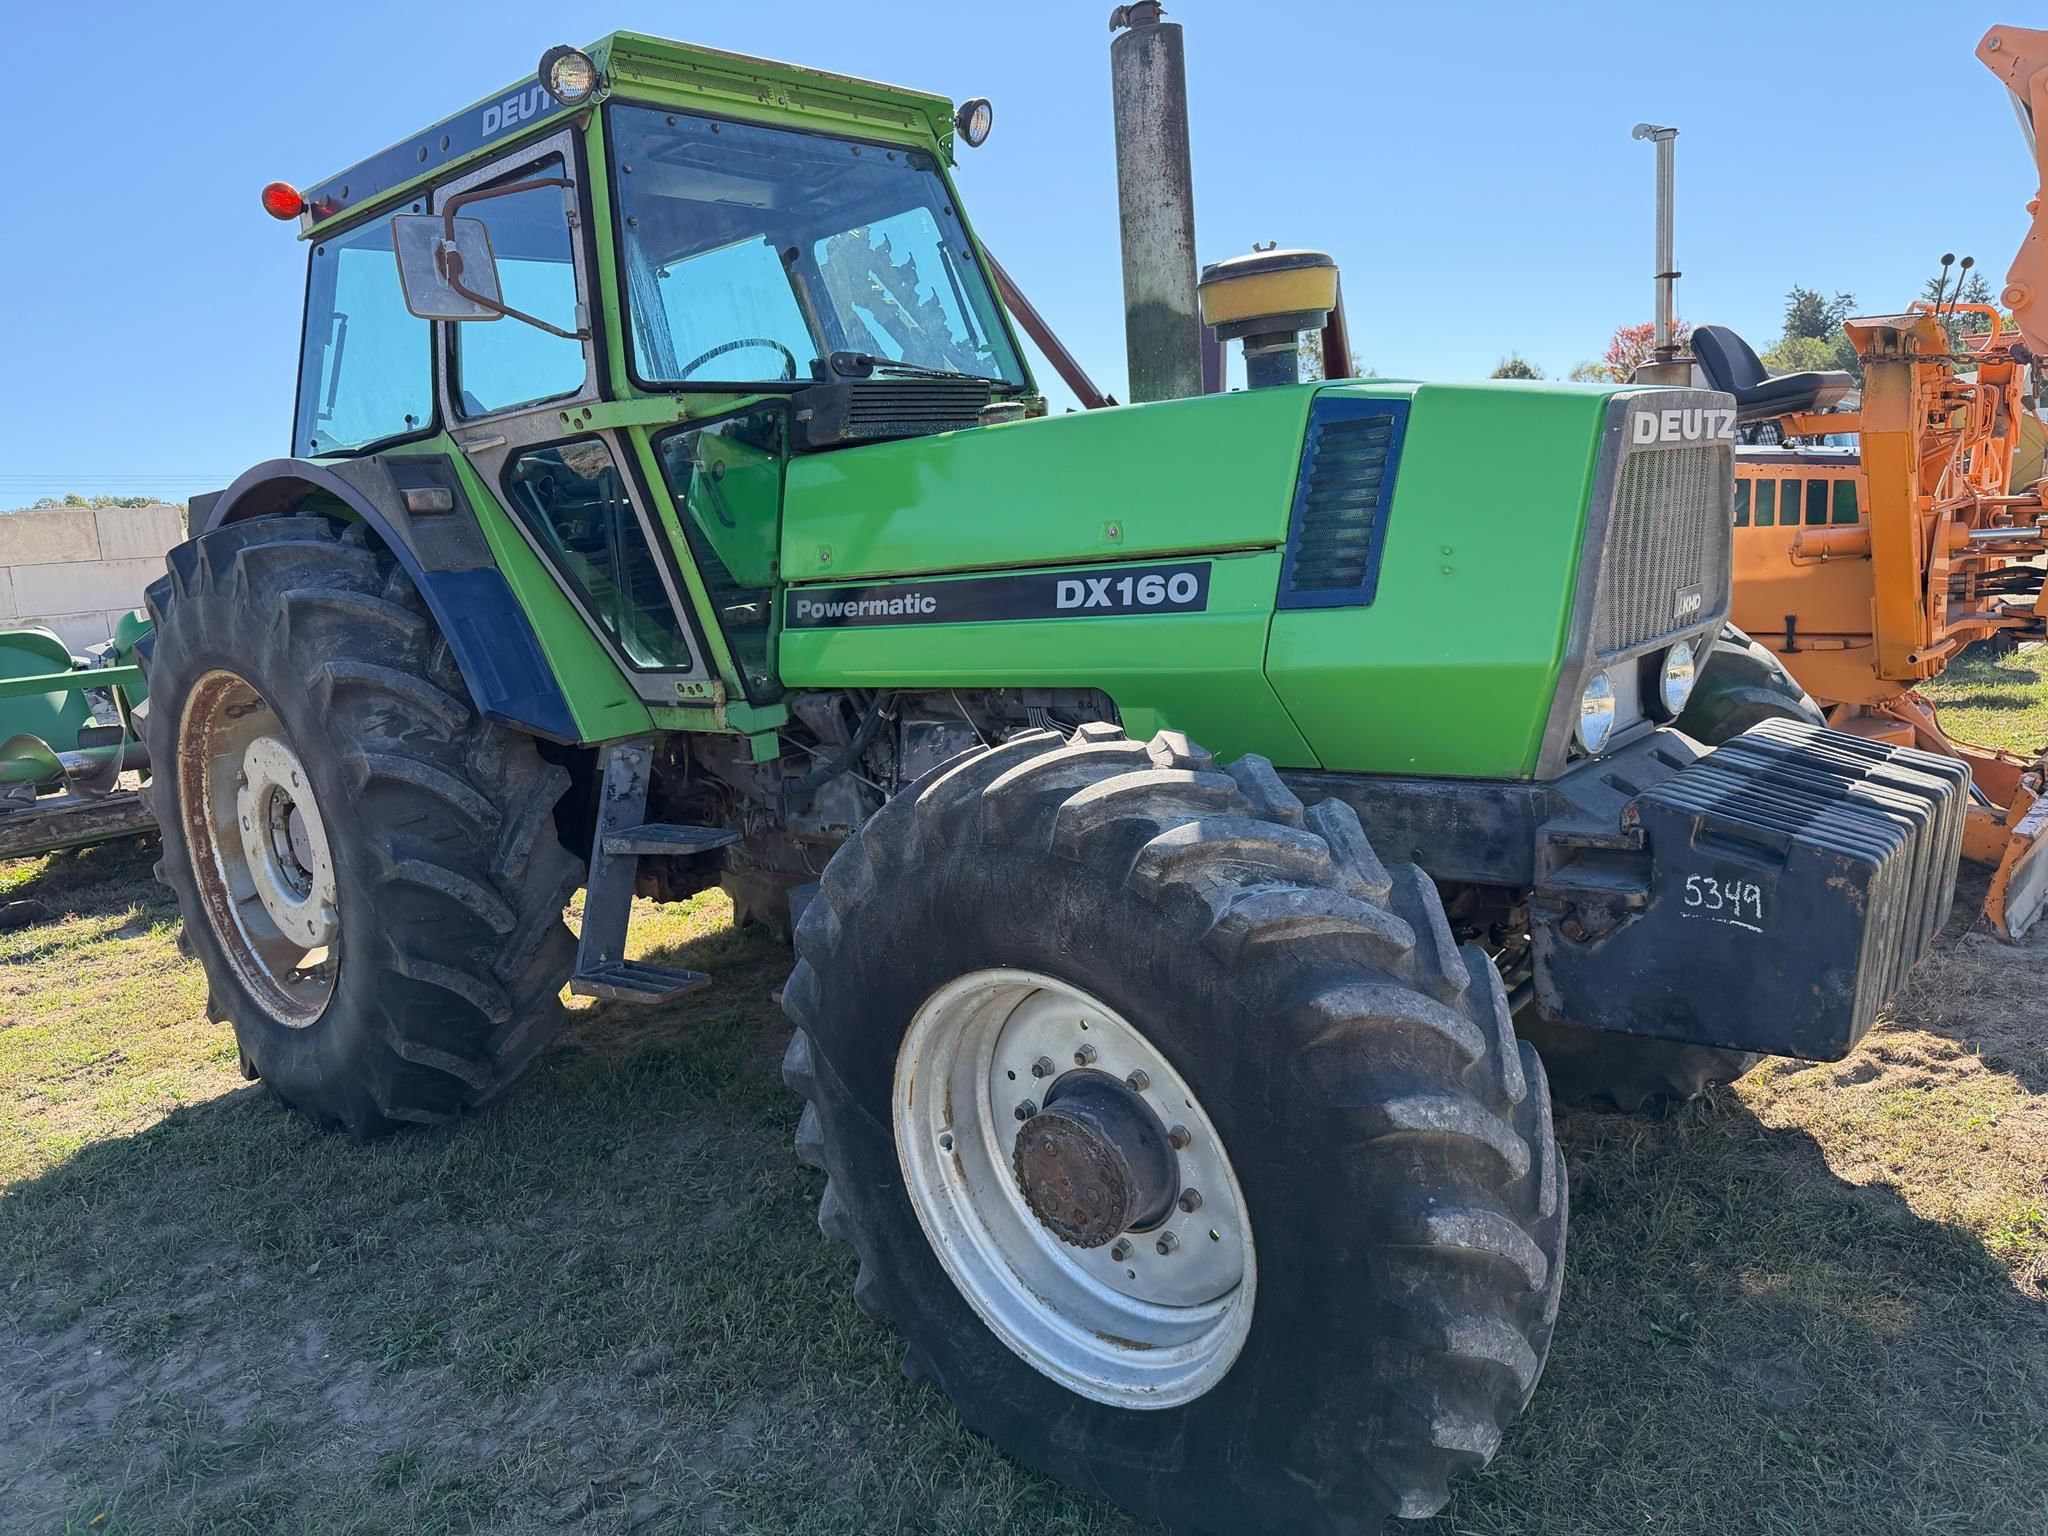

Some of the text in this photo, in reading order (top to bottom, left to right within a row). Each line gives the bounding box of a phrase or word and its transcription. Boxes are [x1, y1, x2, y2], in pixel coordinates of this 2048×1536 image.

[482, 85, 559, 137] DEUT
[1632, 408, 1736, 445] DEUTZ
[796, 572, 1199, 618] Powermatic DX160
[1684, 873, 1762, 919] 5349
